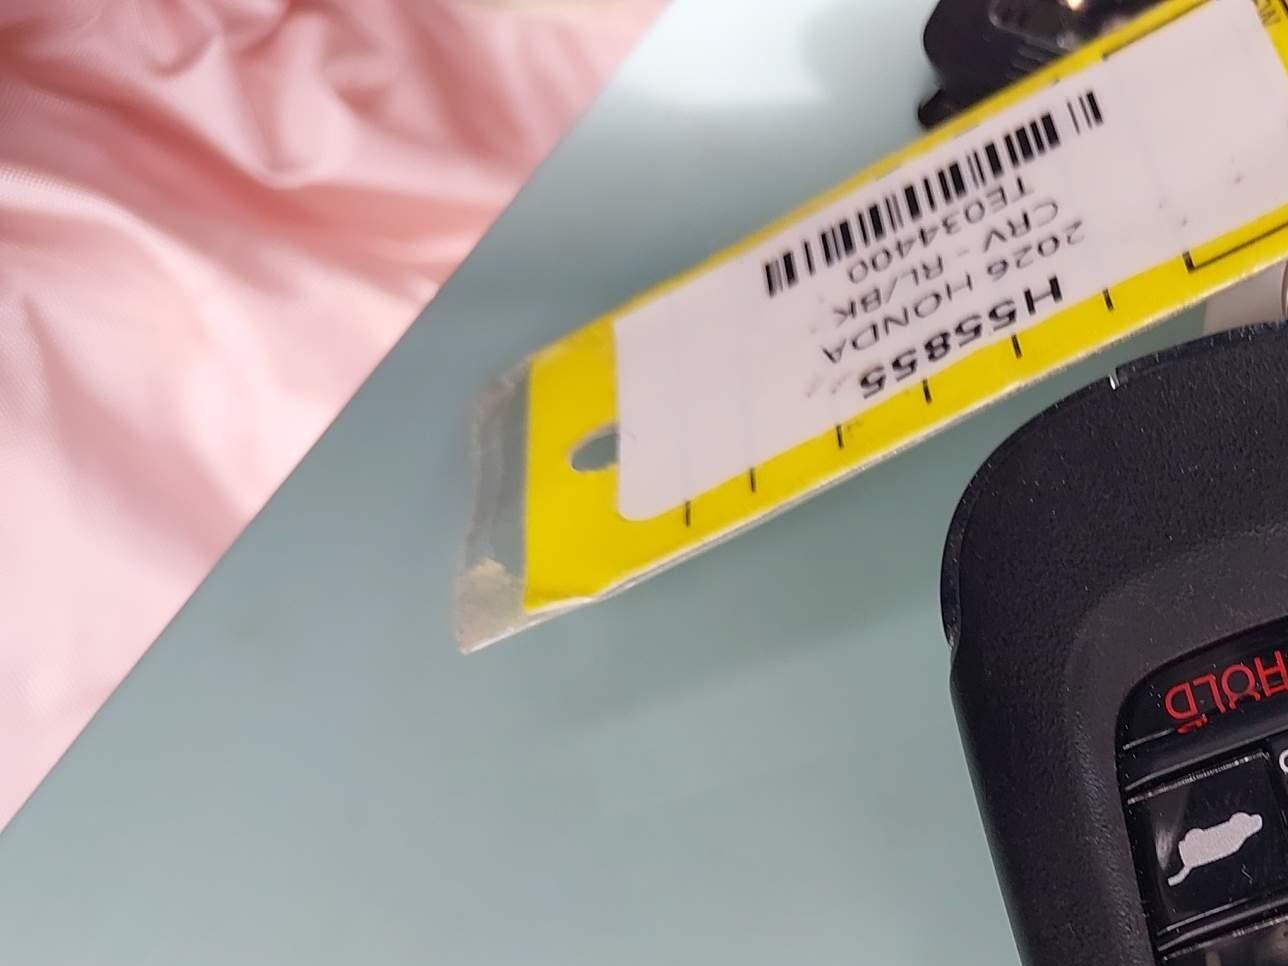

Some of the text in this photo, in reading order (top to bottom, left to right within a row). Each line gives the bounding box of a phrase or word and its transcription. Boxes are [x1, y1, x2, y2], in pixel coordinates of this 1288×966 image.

[847, 175, 1034, 284] TE034400
[983, 200, 1059, 253] CRV
[822, 218, 1085, 364] 2026 HONDA
[833, 255, 944, 328] RL/BK
[859, 274, 1064, 399] H55855
